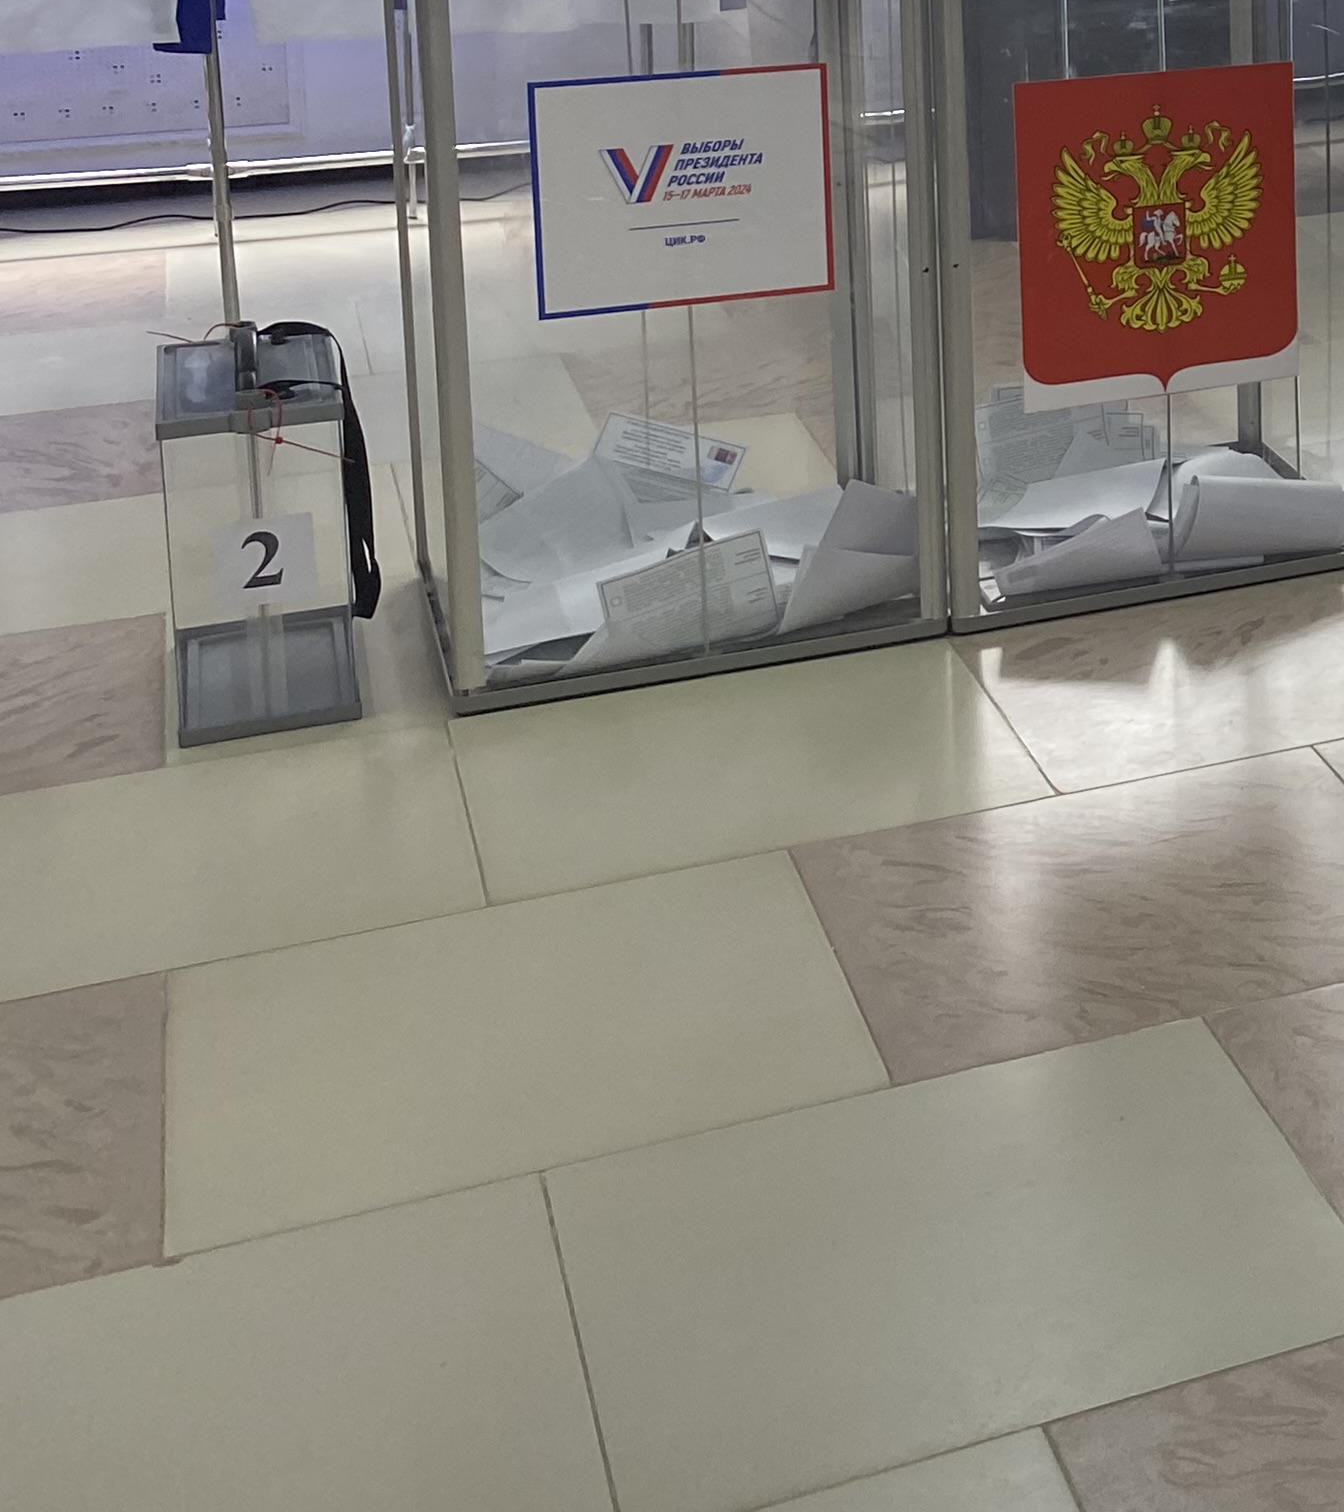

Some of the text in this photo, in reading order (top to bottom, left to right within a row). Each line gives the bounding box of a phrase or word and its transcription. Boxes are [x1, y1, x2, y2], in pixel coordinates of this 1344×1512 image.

[680, 138, 744, 155] ВЫБОРЫ
[674, 152, 763, 171] ПРЕЗИДЕНТА
[667, 171, 725, 187] РОССИИ
[692, 186, 726, 199] МАРТА
[727, 184, 752, 196] 2024
[665, 235, 706, 247] ЦИК.РФ
[241, 531, 284, 589] 2
